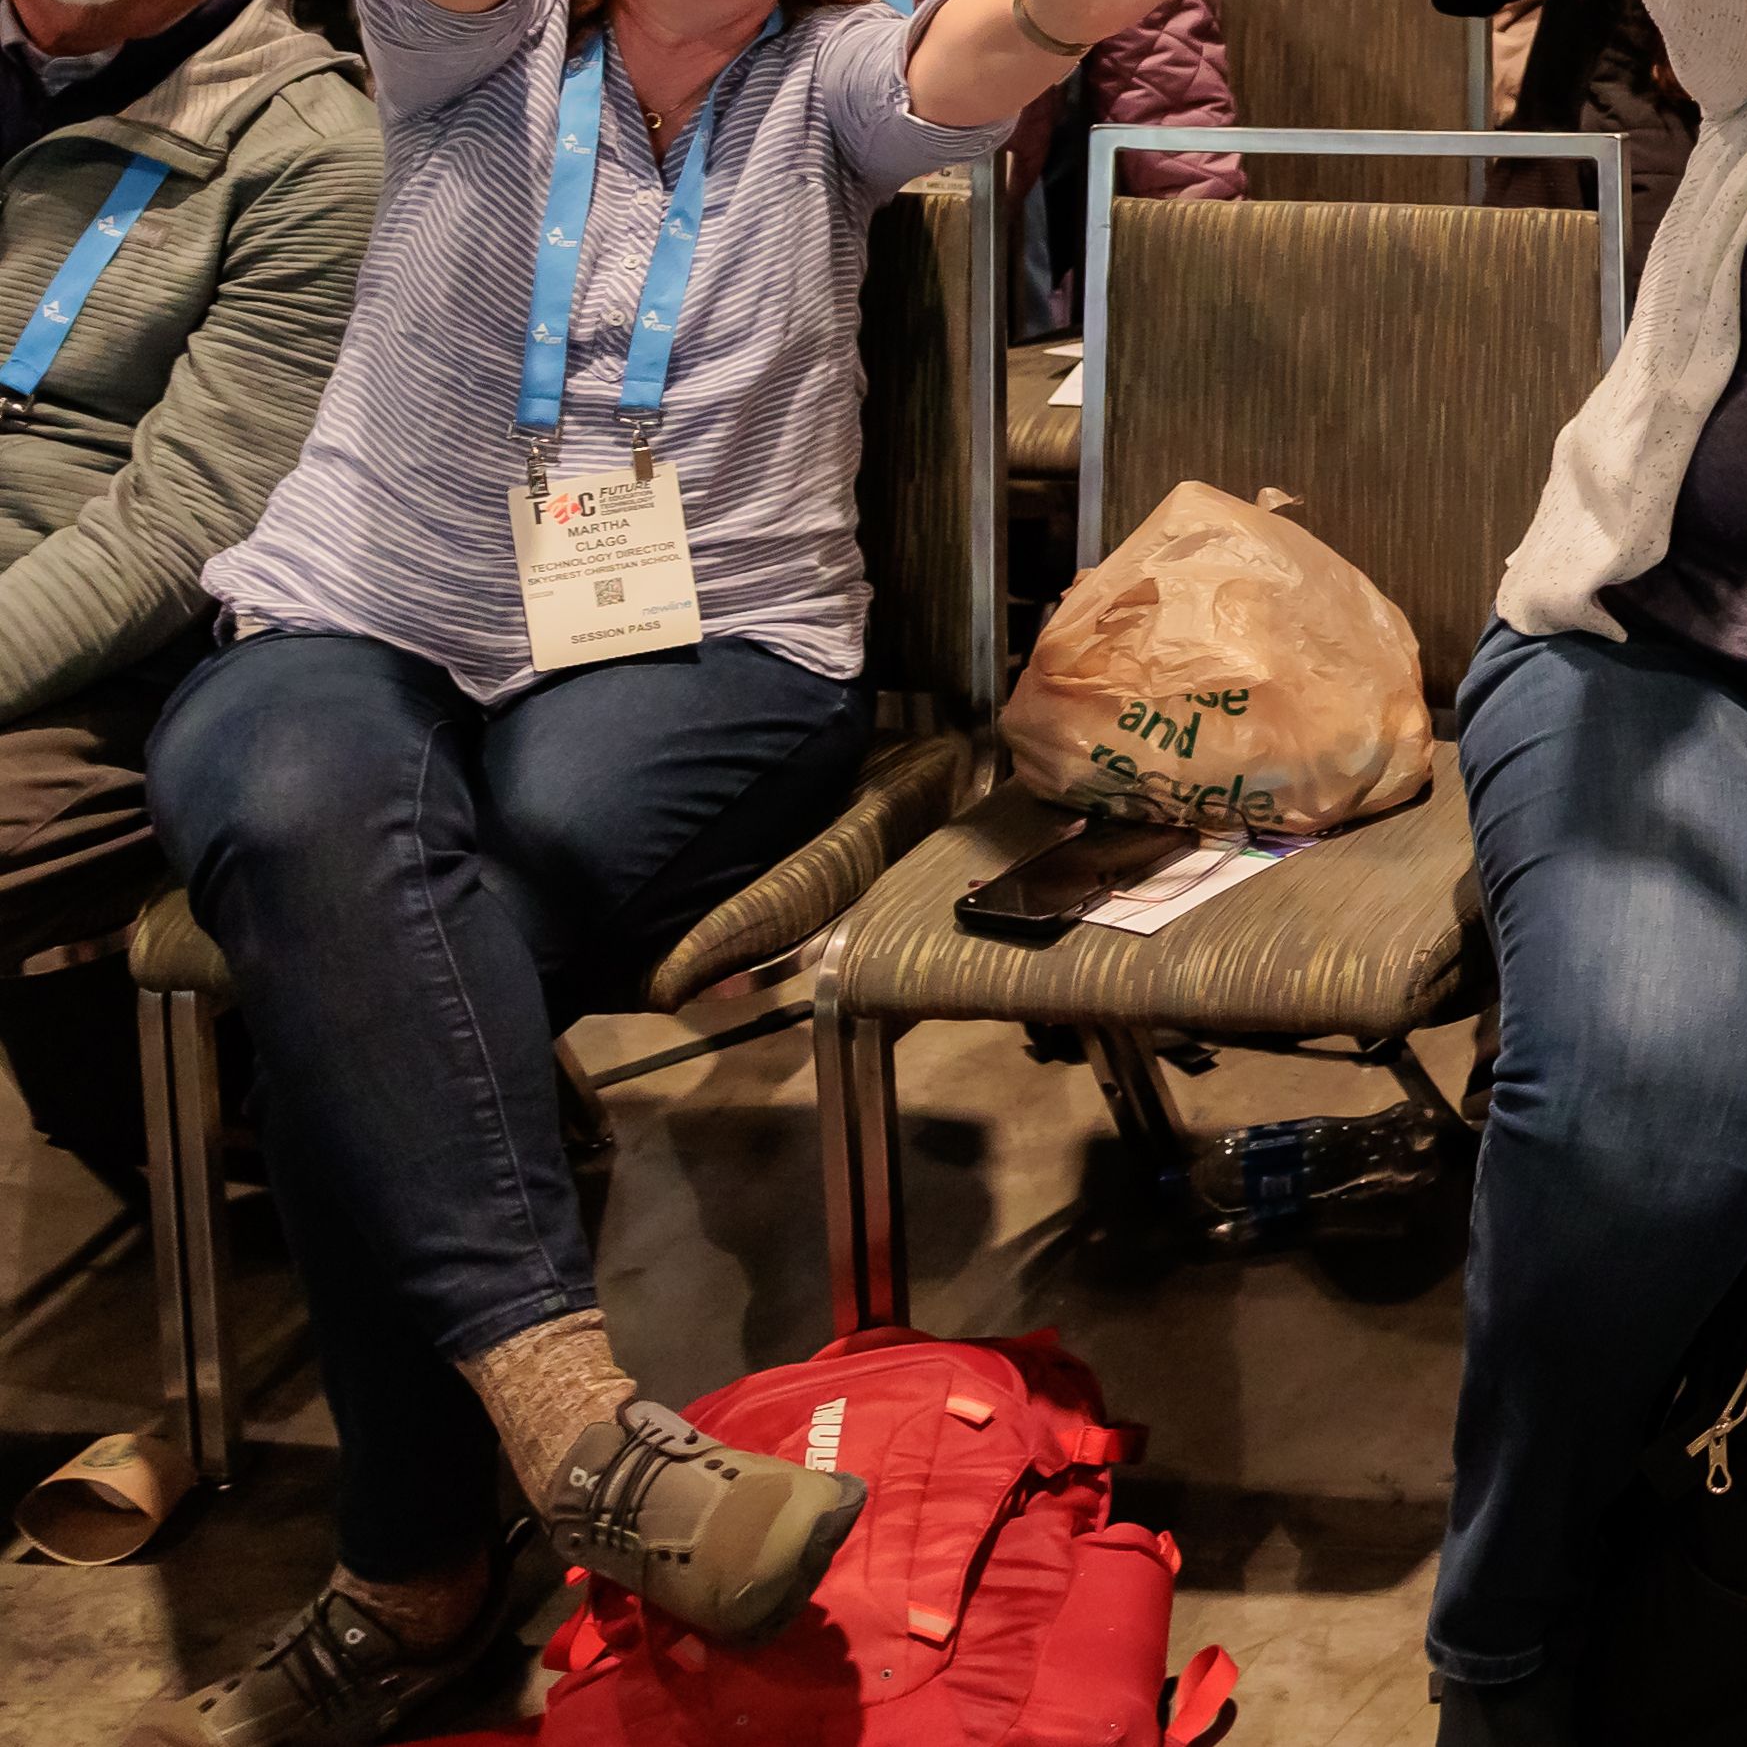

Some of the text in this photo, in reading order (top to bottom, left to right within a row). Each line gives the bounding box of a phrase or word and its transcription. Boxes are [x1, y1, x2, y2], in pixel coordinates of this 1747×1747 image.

[600, 481, 651, 498] FUTURE
[567, 518, 631, 538] MARTHA
[530, 541, 676, 574] TECHNOLOGY DIRECTOR
[575, 534, 628, 553] CLAGG
[527, 553, 681, 586] SKYCREST CHRISTIAN SCHOOL
[571, 620, 662, 644] SESSION PASS
[1118, 701, 1202, 759] and
[804, 1397, 848, 1472] THULE
